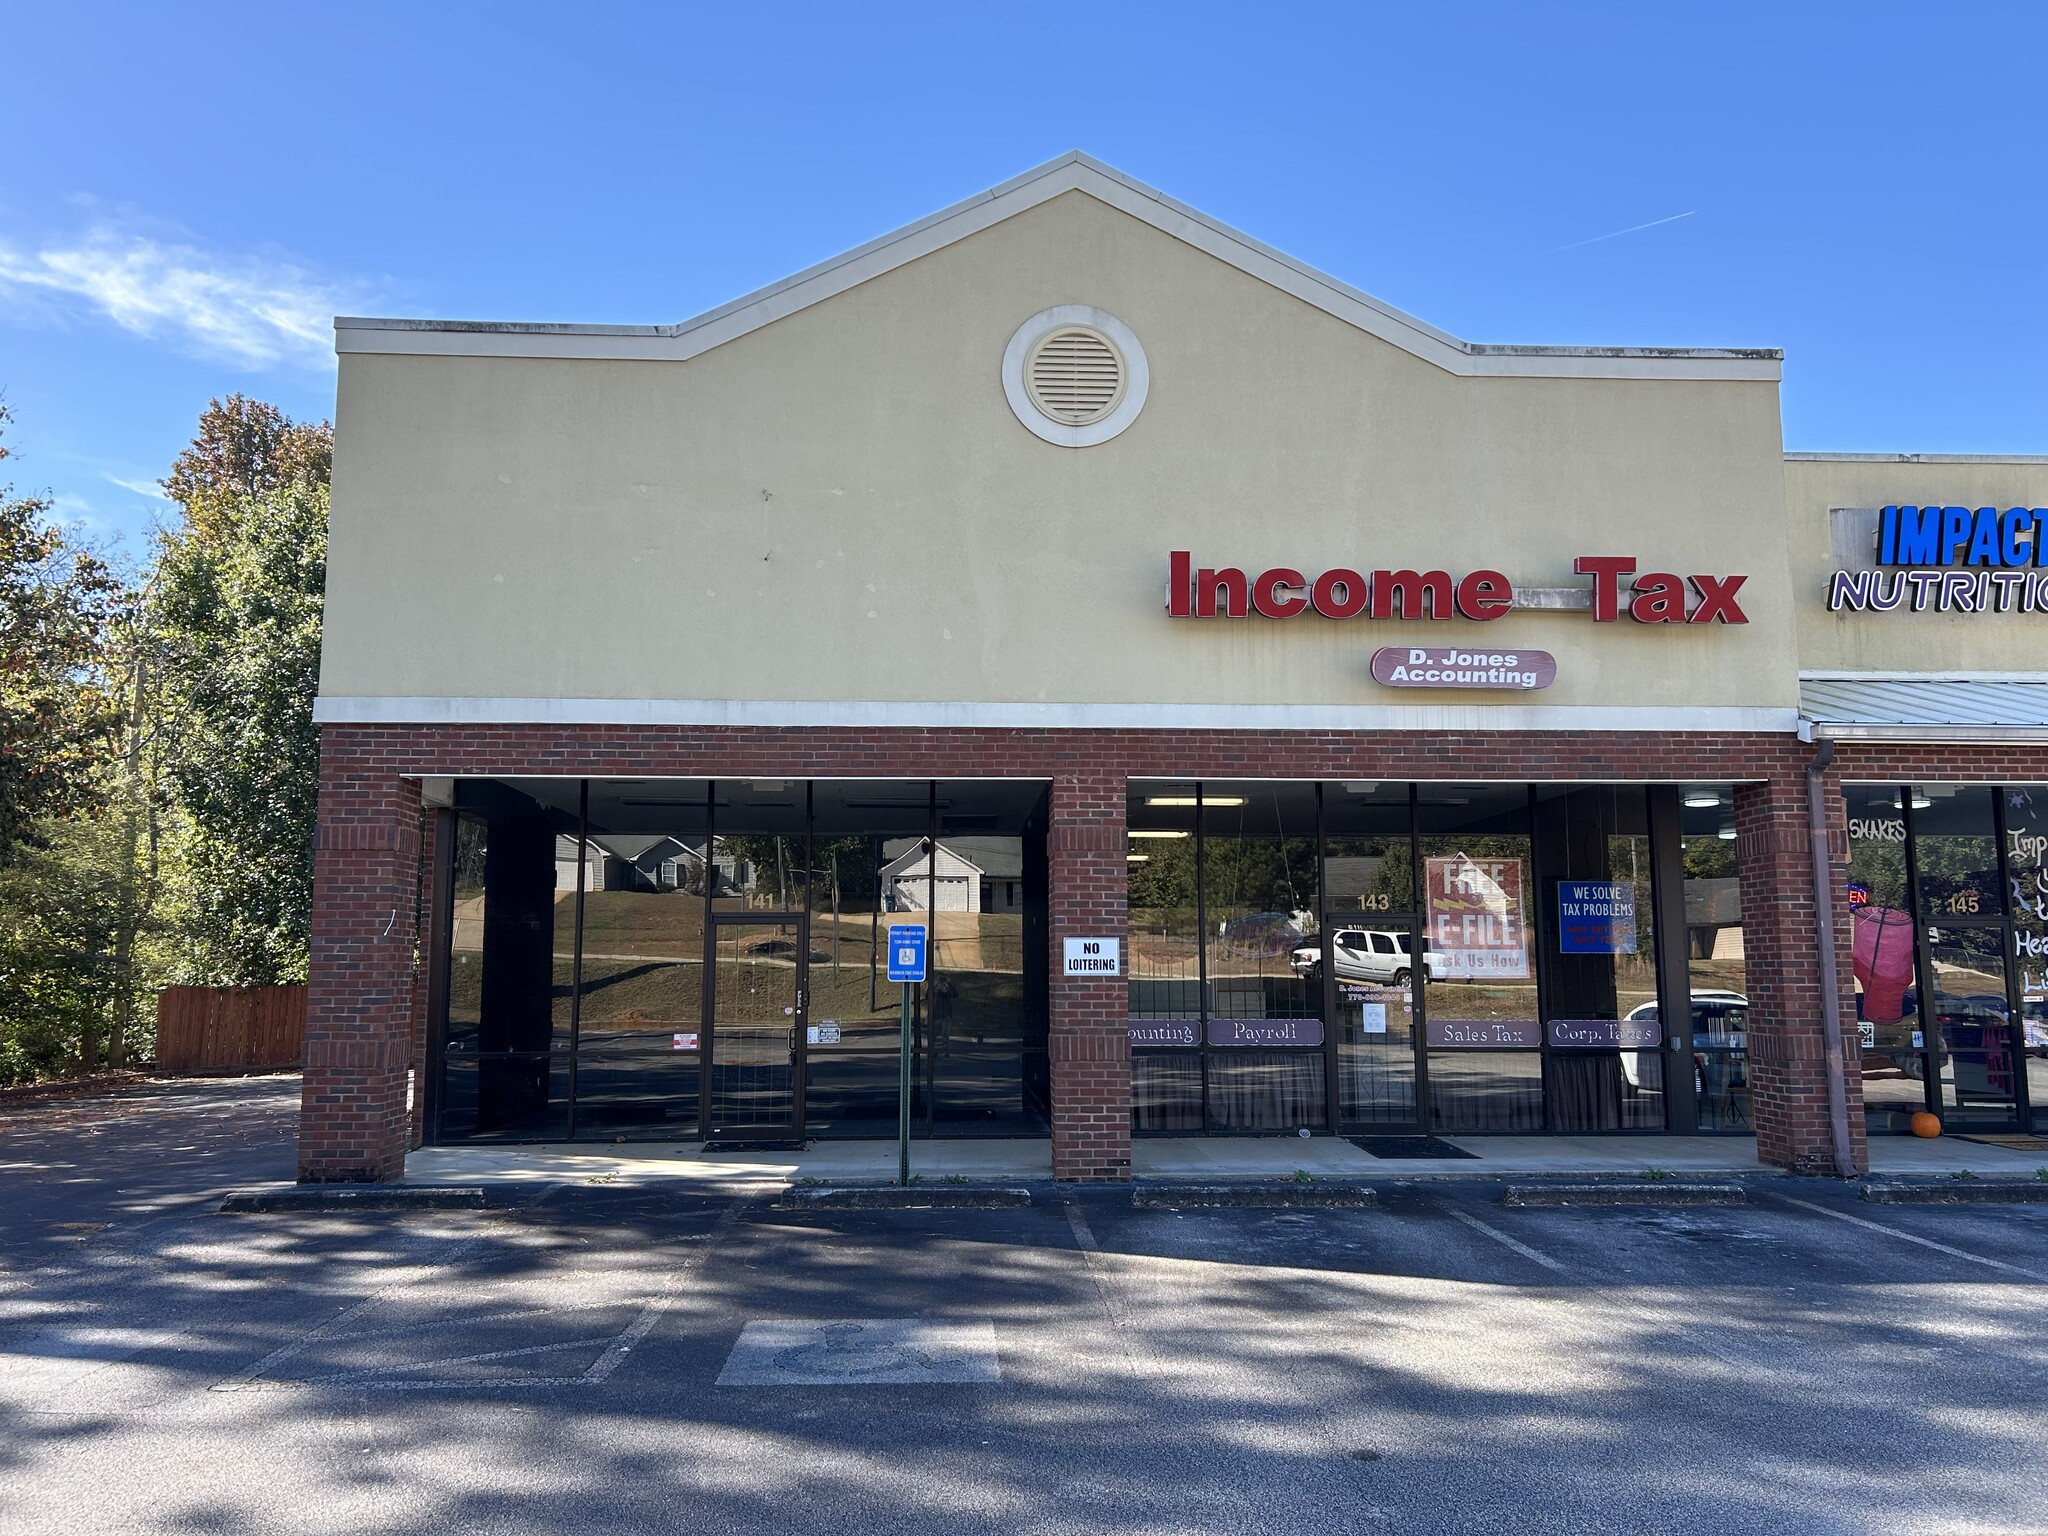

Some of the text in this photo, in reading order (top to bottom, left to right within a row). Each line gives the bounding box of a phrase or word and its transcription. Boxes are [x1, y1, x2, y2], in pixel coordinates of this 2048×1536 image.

[1167, 550, 1749, 624] Income Tax
[1409, 649, 1519, 667] D. Jones
[1390, 665, 1537, 688] Accounting
[1848, 818, 1907, 844] SHAKES
[745, 892, 774, 910] 141
[1357, 894, 1390, 910] 143
[1573, 886, 1621, 900] WE SOLVE
[1562, 903, 1633, 916] TAX PROBLEMS
[1948, 896, 1980, 913] 145
[1437, 914, 1517, 946] E-FILE
[1083, 942, 1100, 955] NO
[1068, 958, 1116, 971] LOITERING
[1468, 953, 1484, 968] Us
[1491, 953, 1520, 968] How
[1233, 1022, 1297, 1043] Payroll
[1443, 1024, 1523, 1042] Sales Tax
[1555, 1023, 1653, 1043] Corp. Taxes
